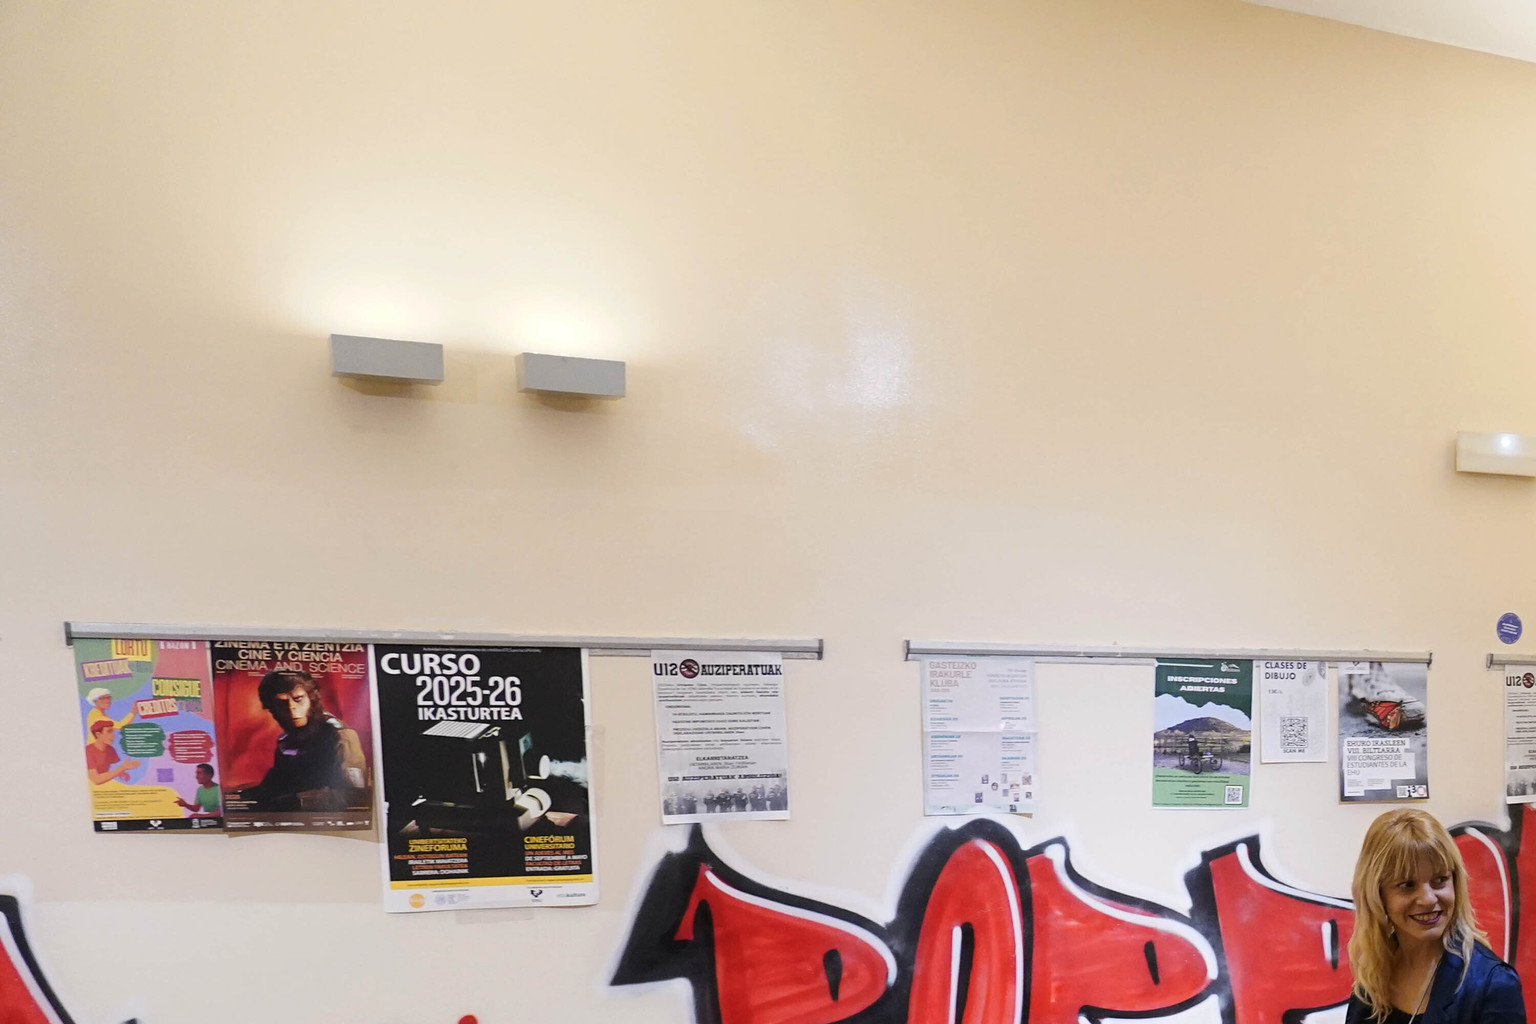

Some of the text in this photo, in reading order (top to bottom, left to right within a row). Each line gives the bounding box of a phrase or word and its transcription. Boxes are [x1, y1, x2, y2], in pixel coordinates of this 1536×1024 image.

[214, 641, 269, 649] ZINEMA
[273, 643, 299, 651] ETA
[238, 650, 343, 662] CINE Y CIENCIA
[215, 660, 365, 674] CINEMA AND SCIENCE
[380, 653, 480, 675] CURSO
[929, 661, 976, 670] GASTEIZKO
[1264, 661, 1307, 670] CLASES DE
[654, 663, 782, 676] U12 AUZIPERATUAK
[929, 670, 972, 678] IRAKURLE
[1167, 675, 1238, 685] INSCRIPCIONES
[1264, 672, 1296, 680] DIBUJO
[1506, 676, 1521, 686] U12
[930, 679, 959, 688] KLUBA
[416, 675, 522, 706] 2025-26
[1179, 685, 1226, 693] ABIERTAS
[417, 707, 523, 721] IKASTURTEA
[524, 834, 575, 843] CINEFÓRUM
[408, 844, 468, 852] ZINEFORUMA
